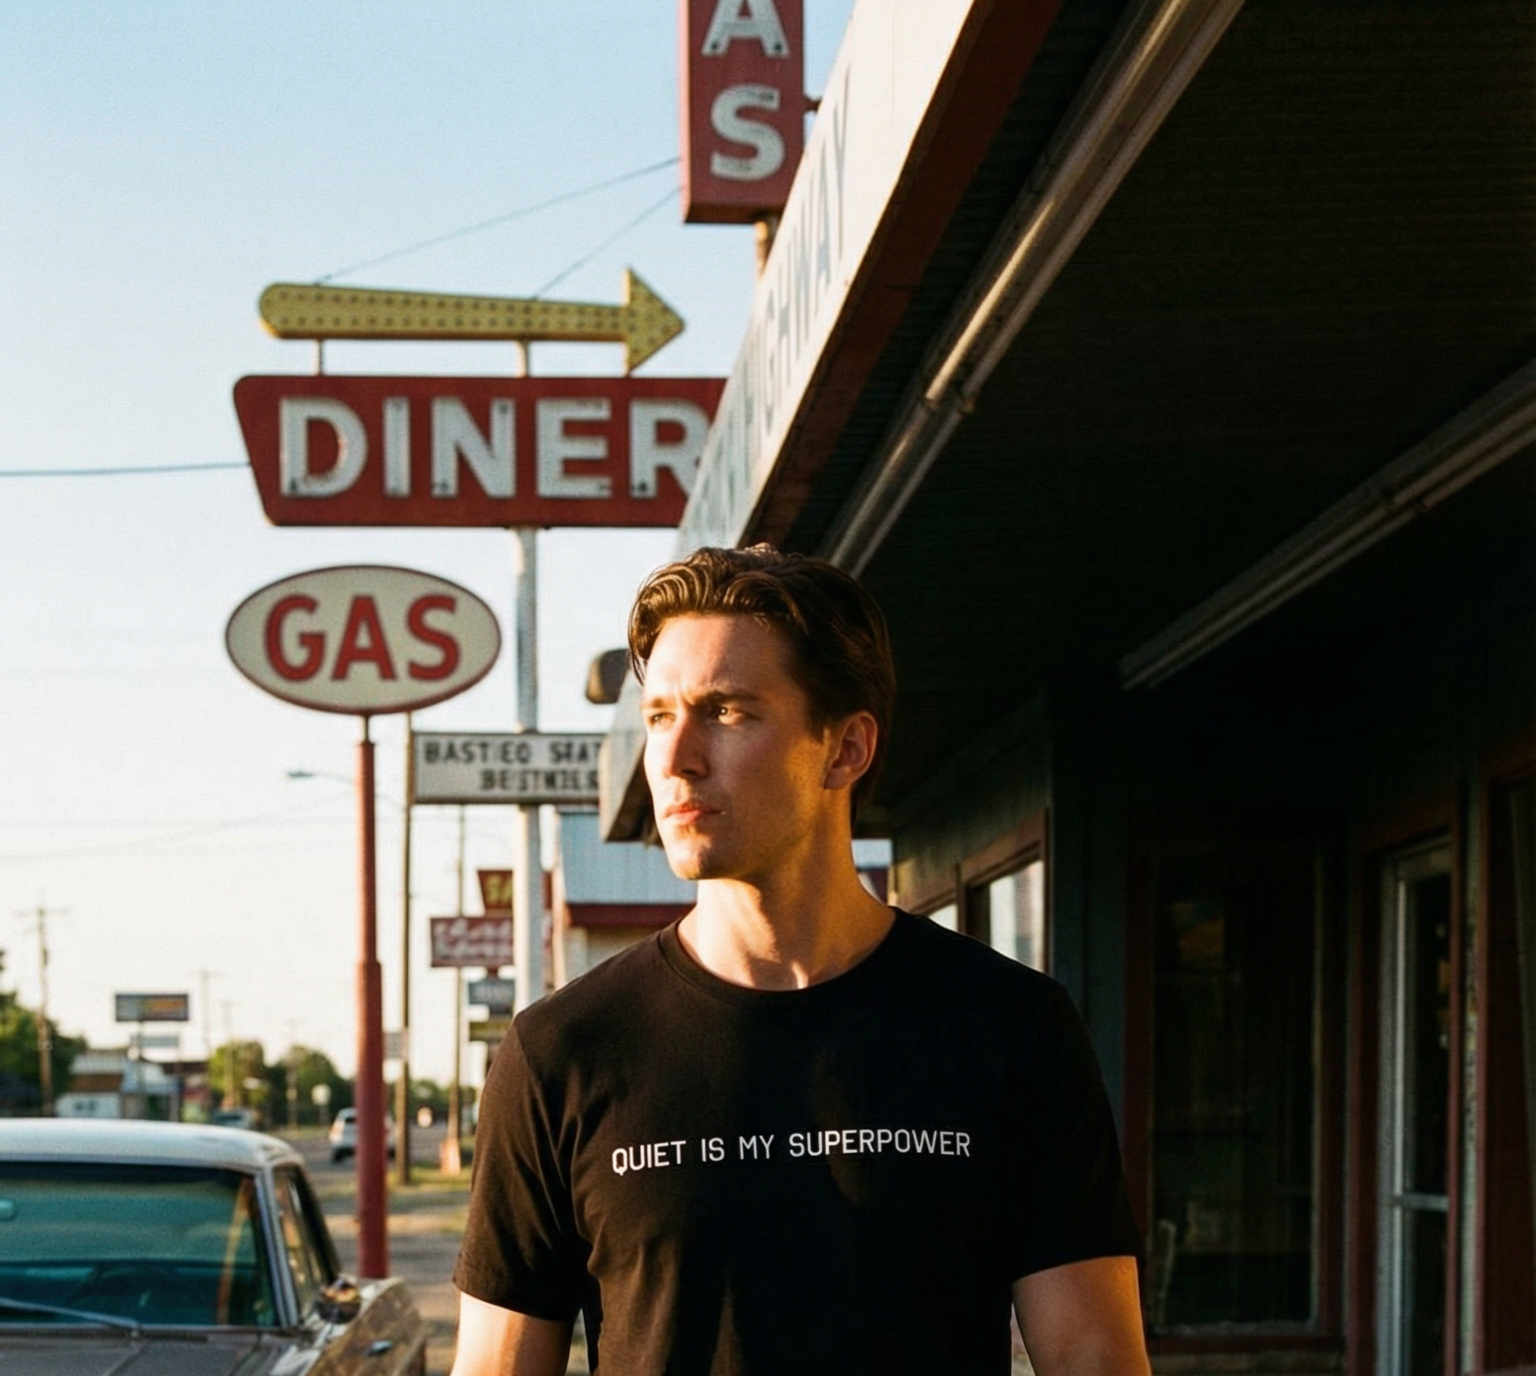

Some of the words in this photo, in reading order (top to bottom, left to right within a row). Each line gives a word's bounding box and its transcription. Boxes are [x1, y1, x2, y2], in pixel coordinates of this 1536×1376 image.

[280, 397, 713, 498] DINER
[264, 593, 461, 682] GAS
[612, 1140, 686, 1176] QUIET
[702, 1138, 724, 1161] IS
[740, 1135, 774, 1159] MY
[789, 1129, 970, 1157] SUPERPOWER
